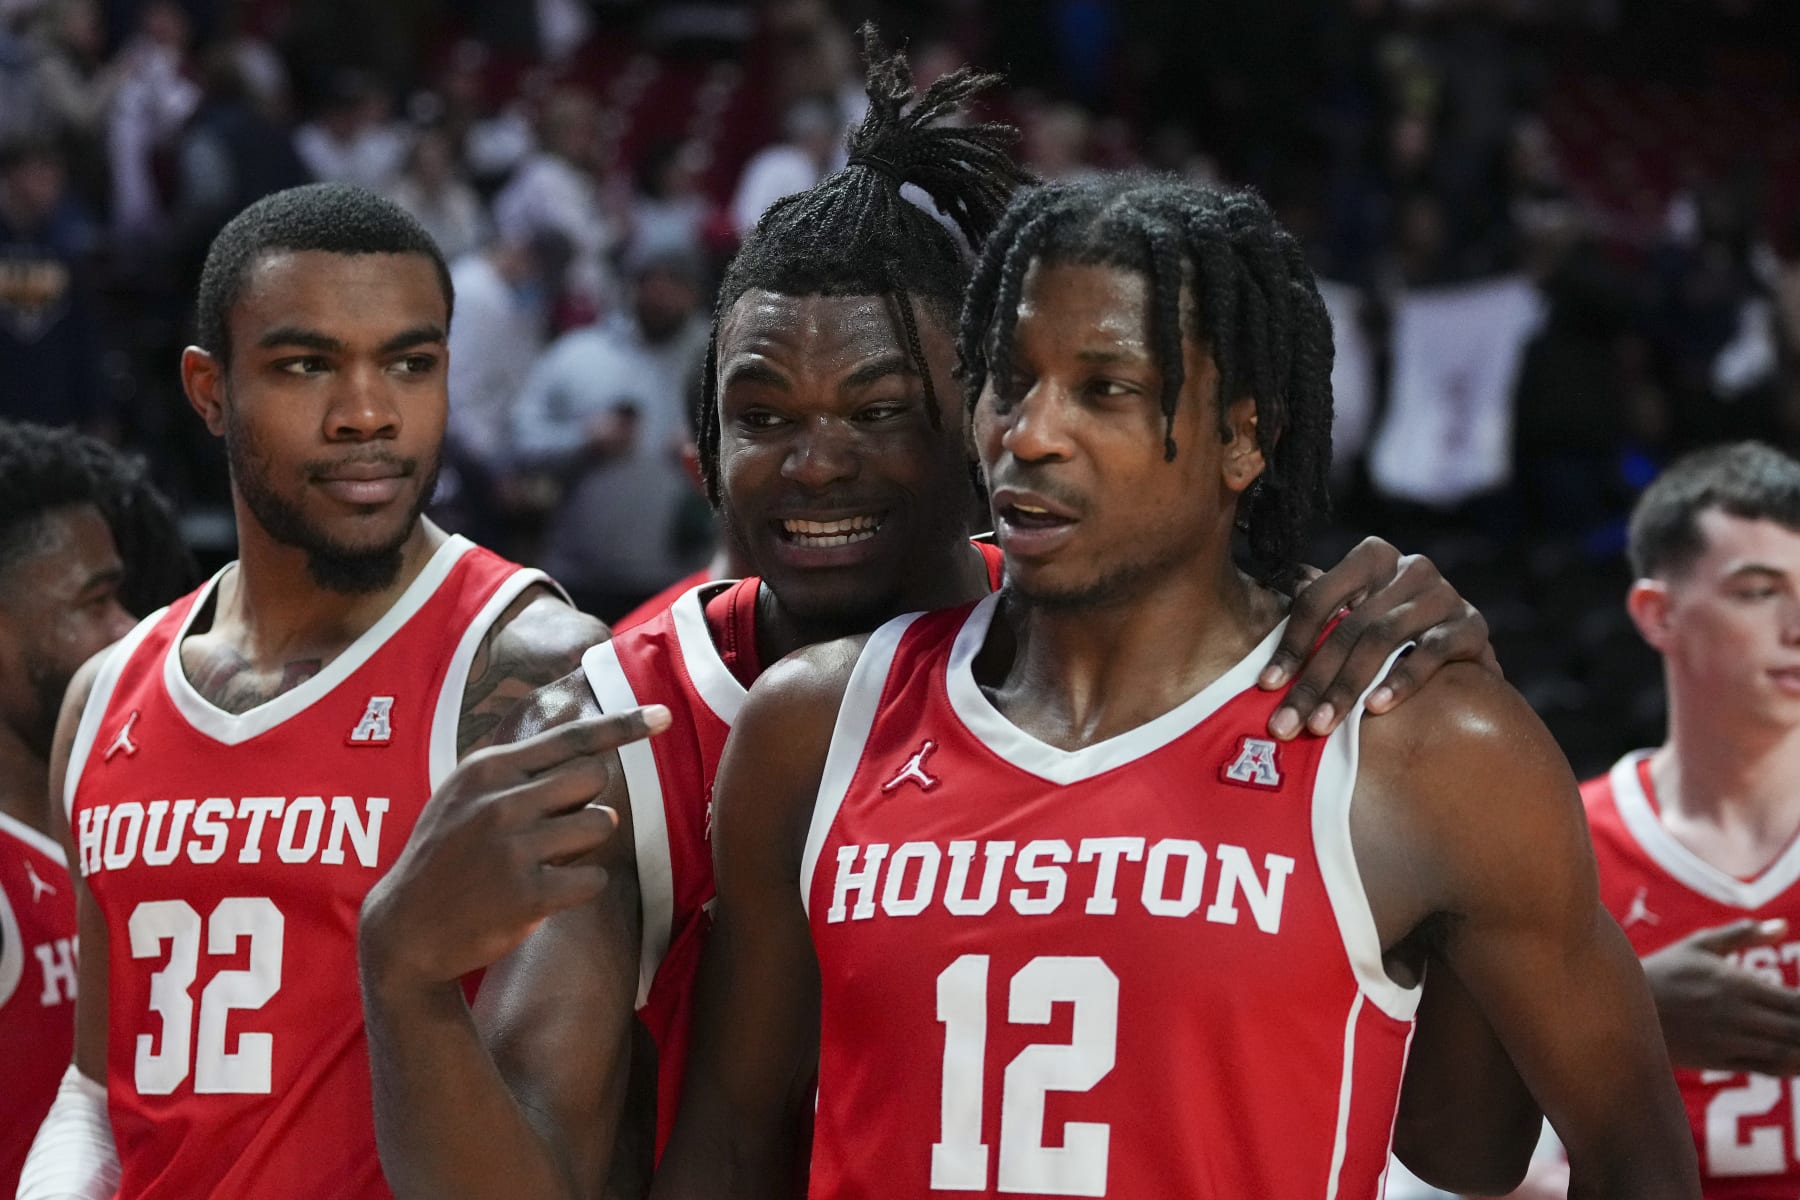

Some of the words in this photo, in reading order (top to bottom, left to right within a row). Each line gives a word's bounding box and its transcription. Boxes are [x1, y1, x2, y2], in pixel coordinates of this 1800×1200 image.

[351, 696, 394, 740] A
[1226, 737, 1280, 785] A
[78, 796, 390, 877] HOUSTON
[827, 837, 1296, 935] HOUSTON
[128, 897, 285, 1095] 32
[929, 954, 1120, 1198] 12
